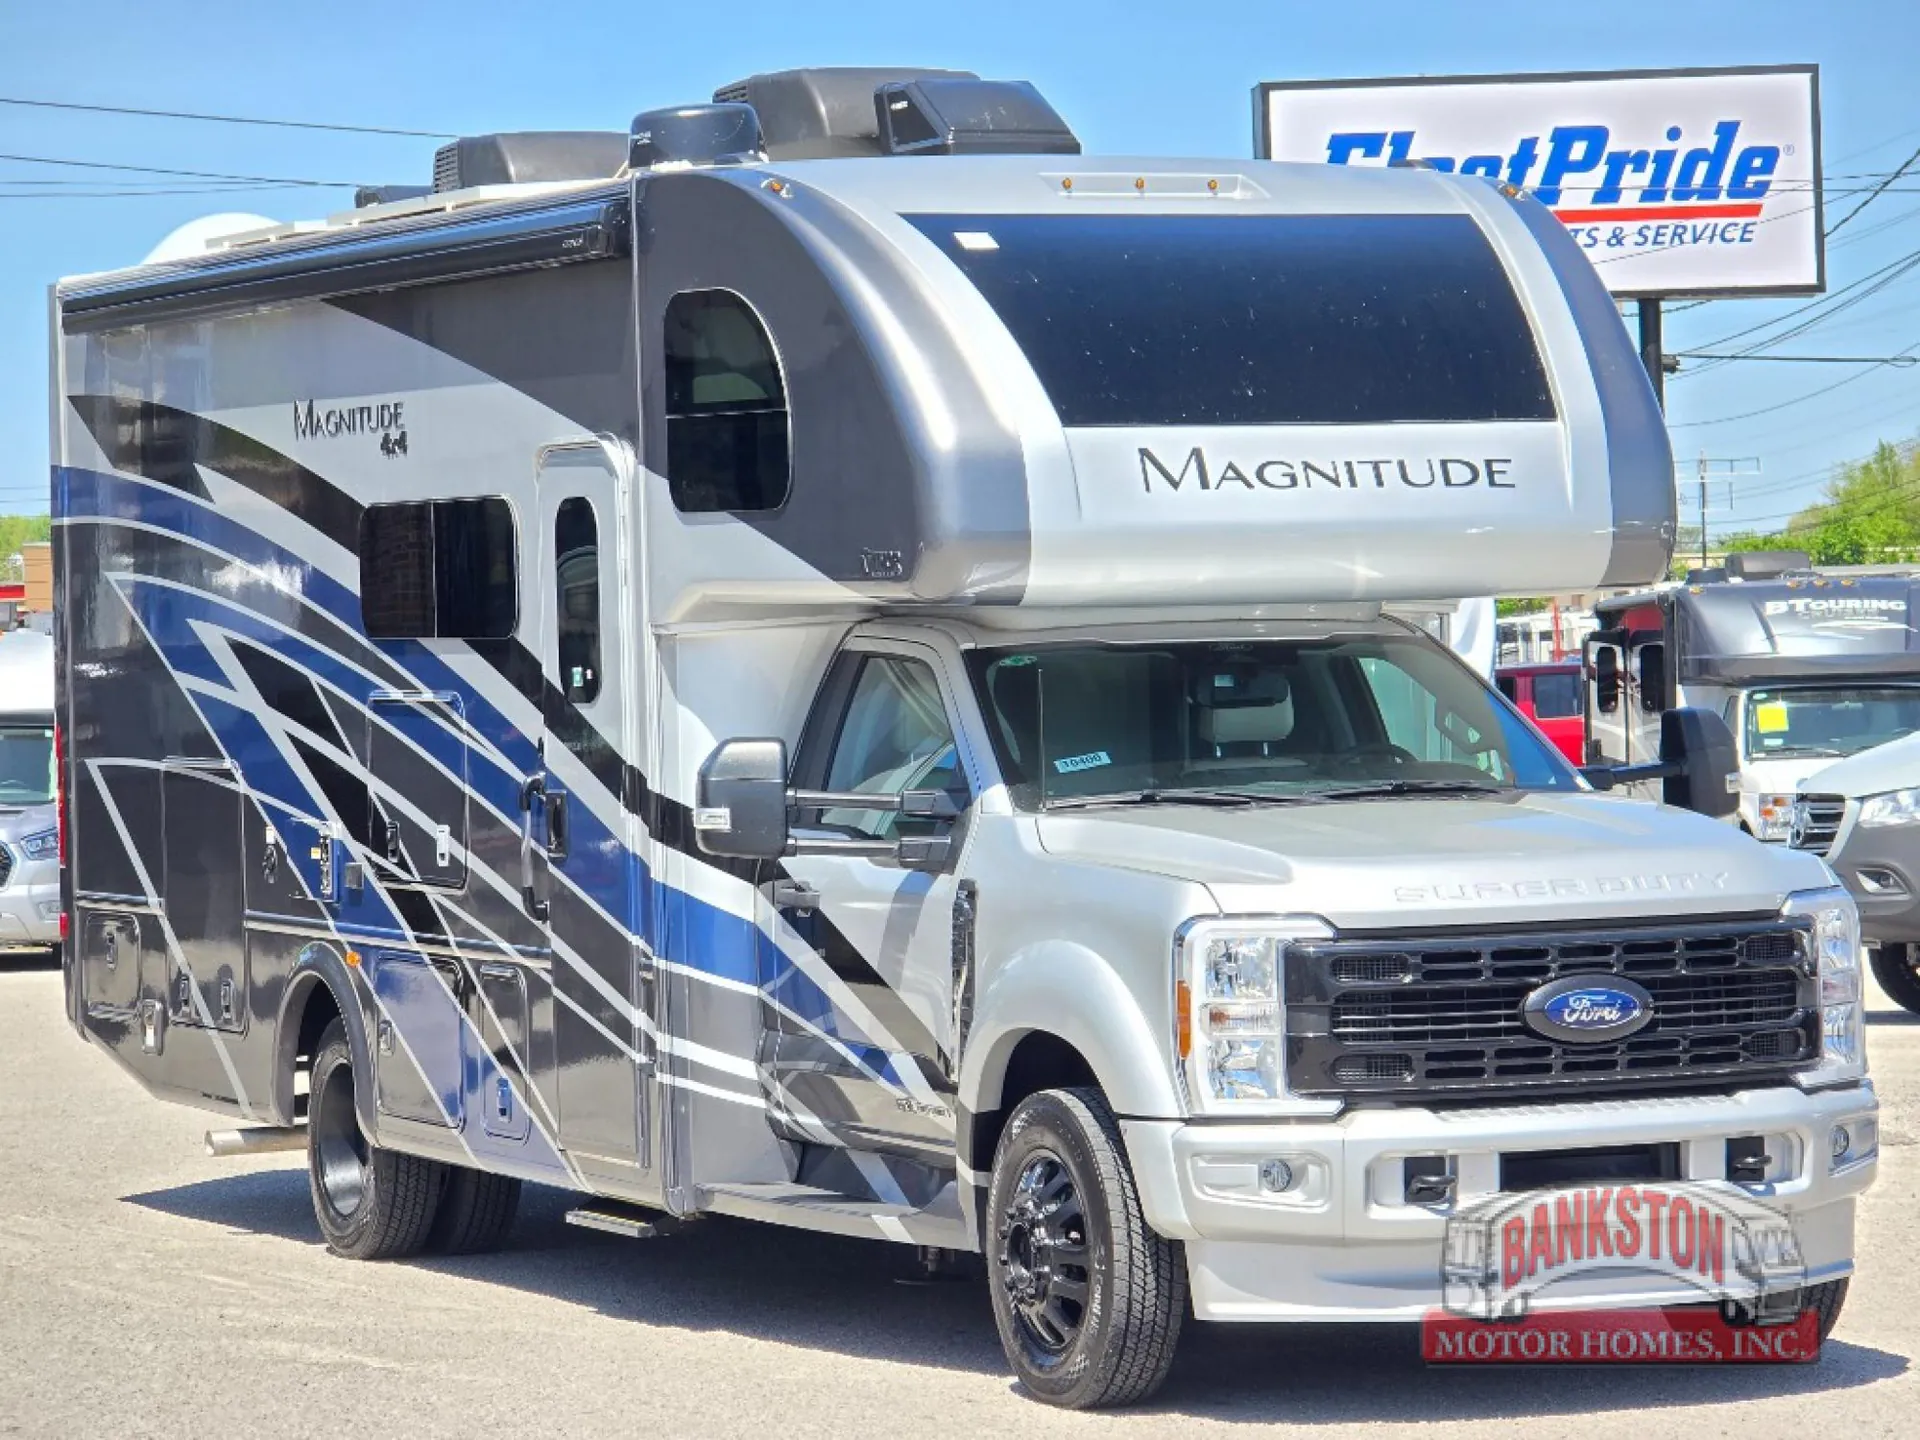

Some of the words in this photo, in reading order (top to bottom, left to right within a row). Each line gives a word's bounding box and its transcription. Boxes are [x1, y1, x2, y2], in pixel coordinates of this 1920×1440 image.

[1606, 226, 1625, 247] &
[1634, 222, 1757, 247] SERVICE
[294, 398, 405, 441] MAGNITUDE
[1138, 446, 1515, 493] MAGNITUDE
[1394, 878, 1589, 902] SUPER
[1597, 871, 1729, 894] DUTY
[1563, 994, 1622, 1022] Ford
